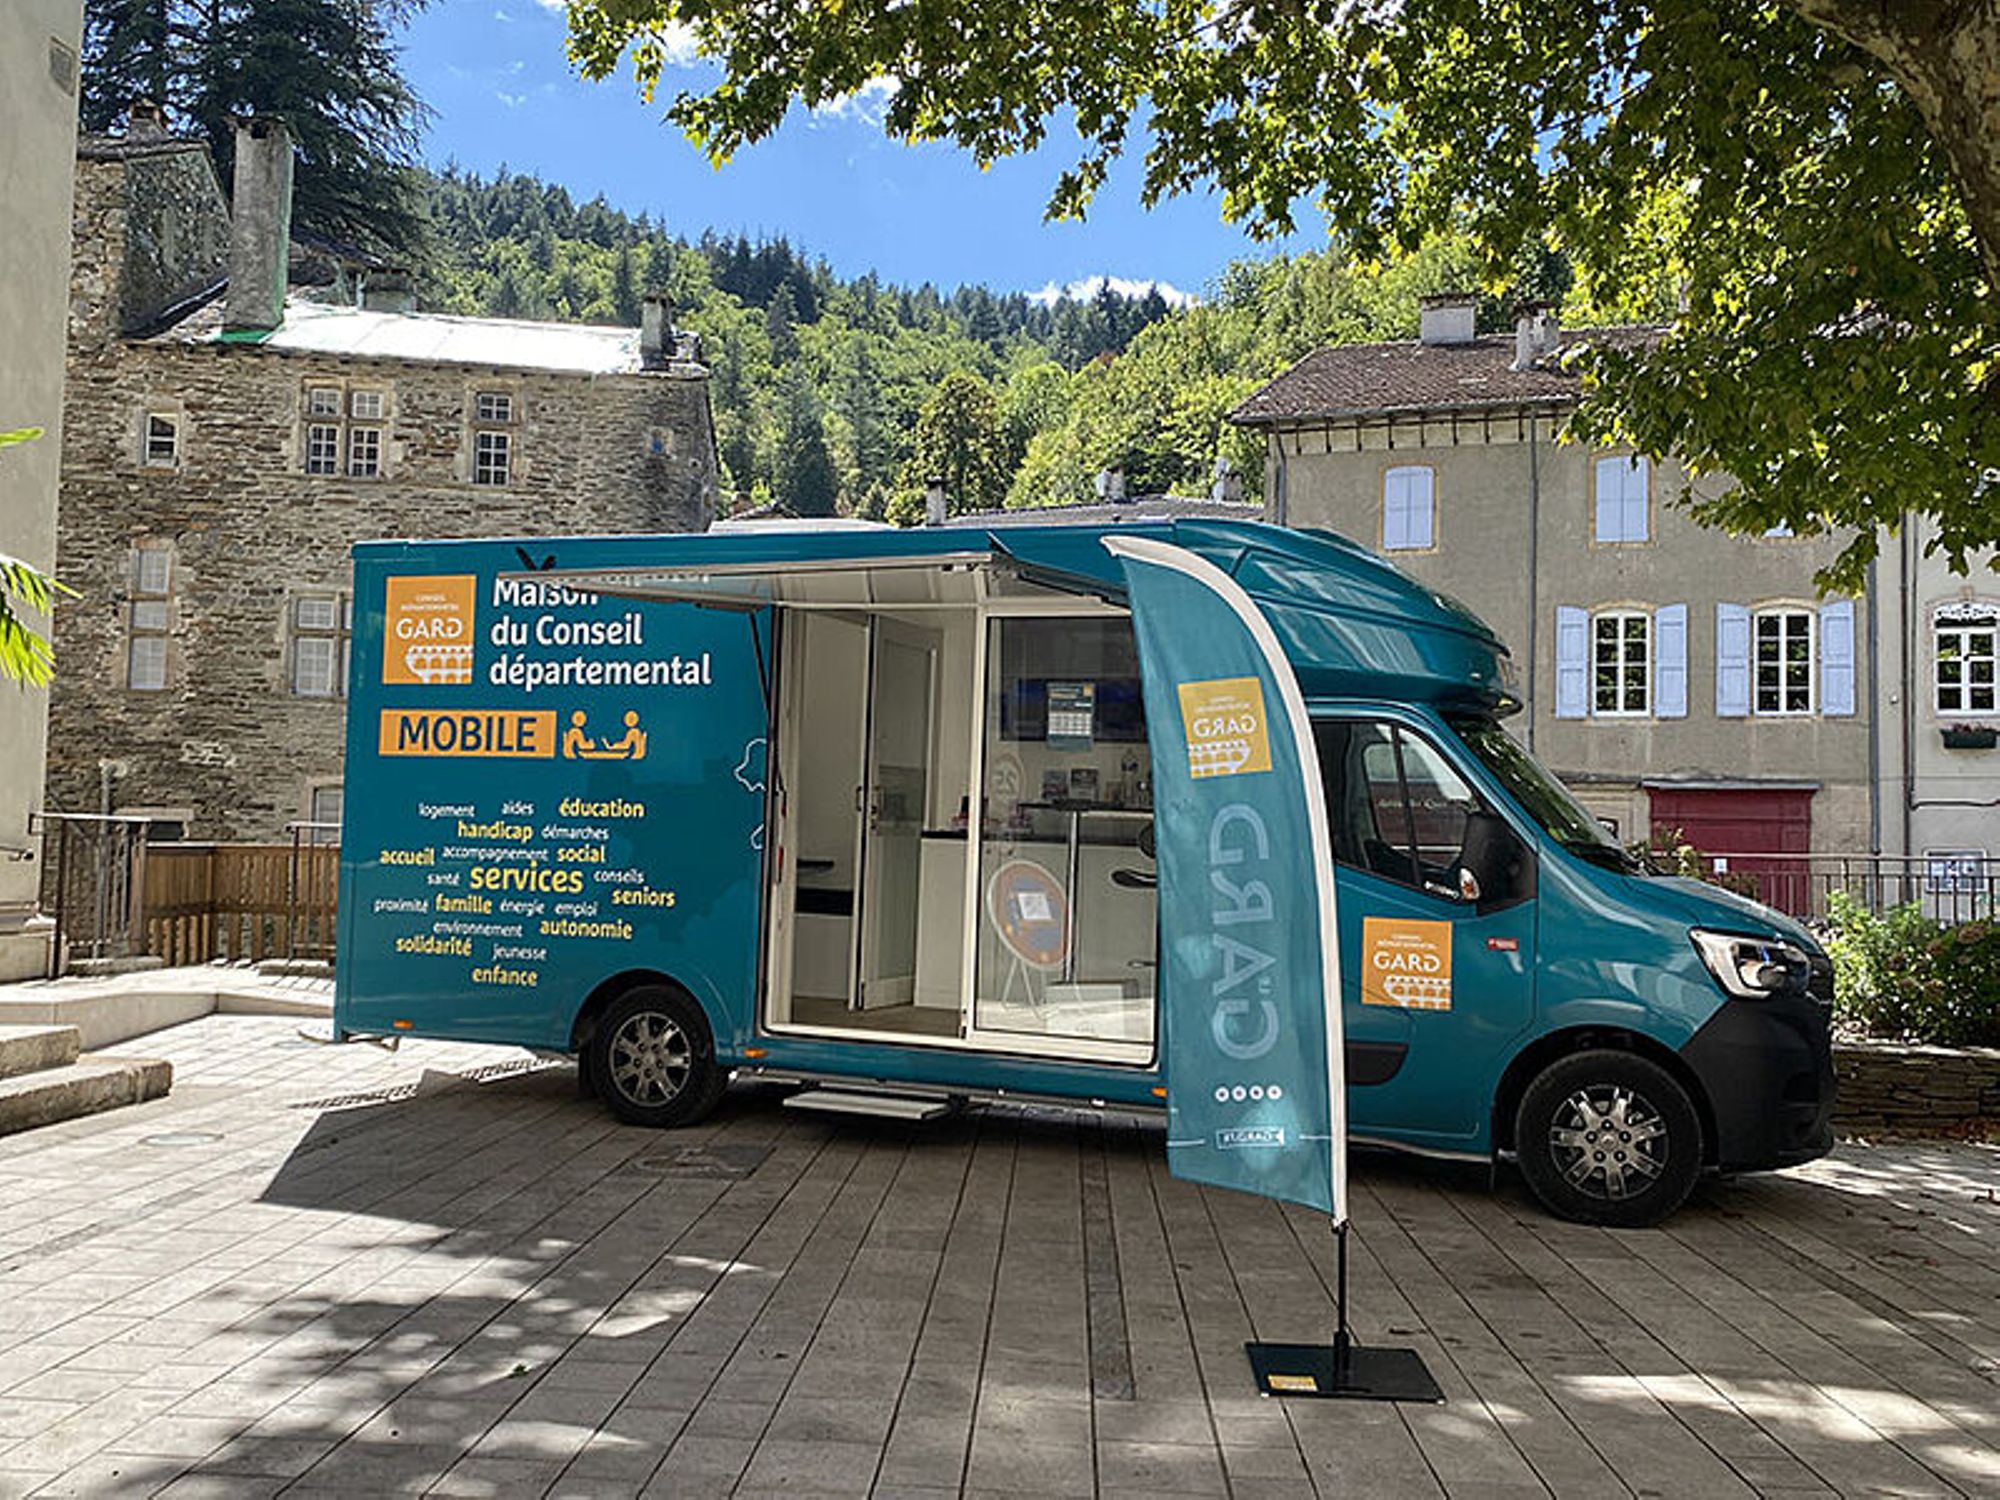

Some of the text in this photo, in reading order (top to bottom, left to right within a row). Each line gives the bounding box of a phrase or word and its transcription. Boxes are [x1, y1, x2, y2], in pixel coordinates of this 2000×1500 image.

[491, 613, 642, 645] du Conseil
[490, 654, 711, 691] départemental
[398, 715, 537, 752] MOBILE
[418, 803, 475, 819] logement
[502, 801, 534, 815] aides
[559, 798, 644, 817] éducation
[458, 821, 533, 842] handicap
[542, 826, 608, 839] démarches
[380, 848, 434, 865] accueil
[443, 847, 547, 863] accompagnement
[558, 844, 605, 862] social
[428, 874, 459, 885] santé
[470, 861, 583, 893] services
[593, 868, 645, 884] conseils
[436, 894, 492, 914] famille
[613, 886, 674, 906] seniors
[375, 900, 428, 912] proximité
[500, 900, 544, 916] énergie
[555, 903, 596, 917] emploi
[432, 921, 523, 937] environnement
[540, 919, 632, 939] autonomie
[396, 935, 471, 956] solidarité
[492, 944, 547, 961] jeunesse
[473, 965, 537, 986] enfance
